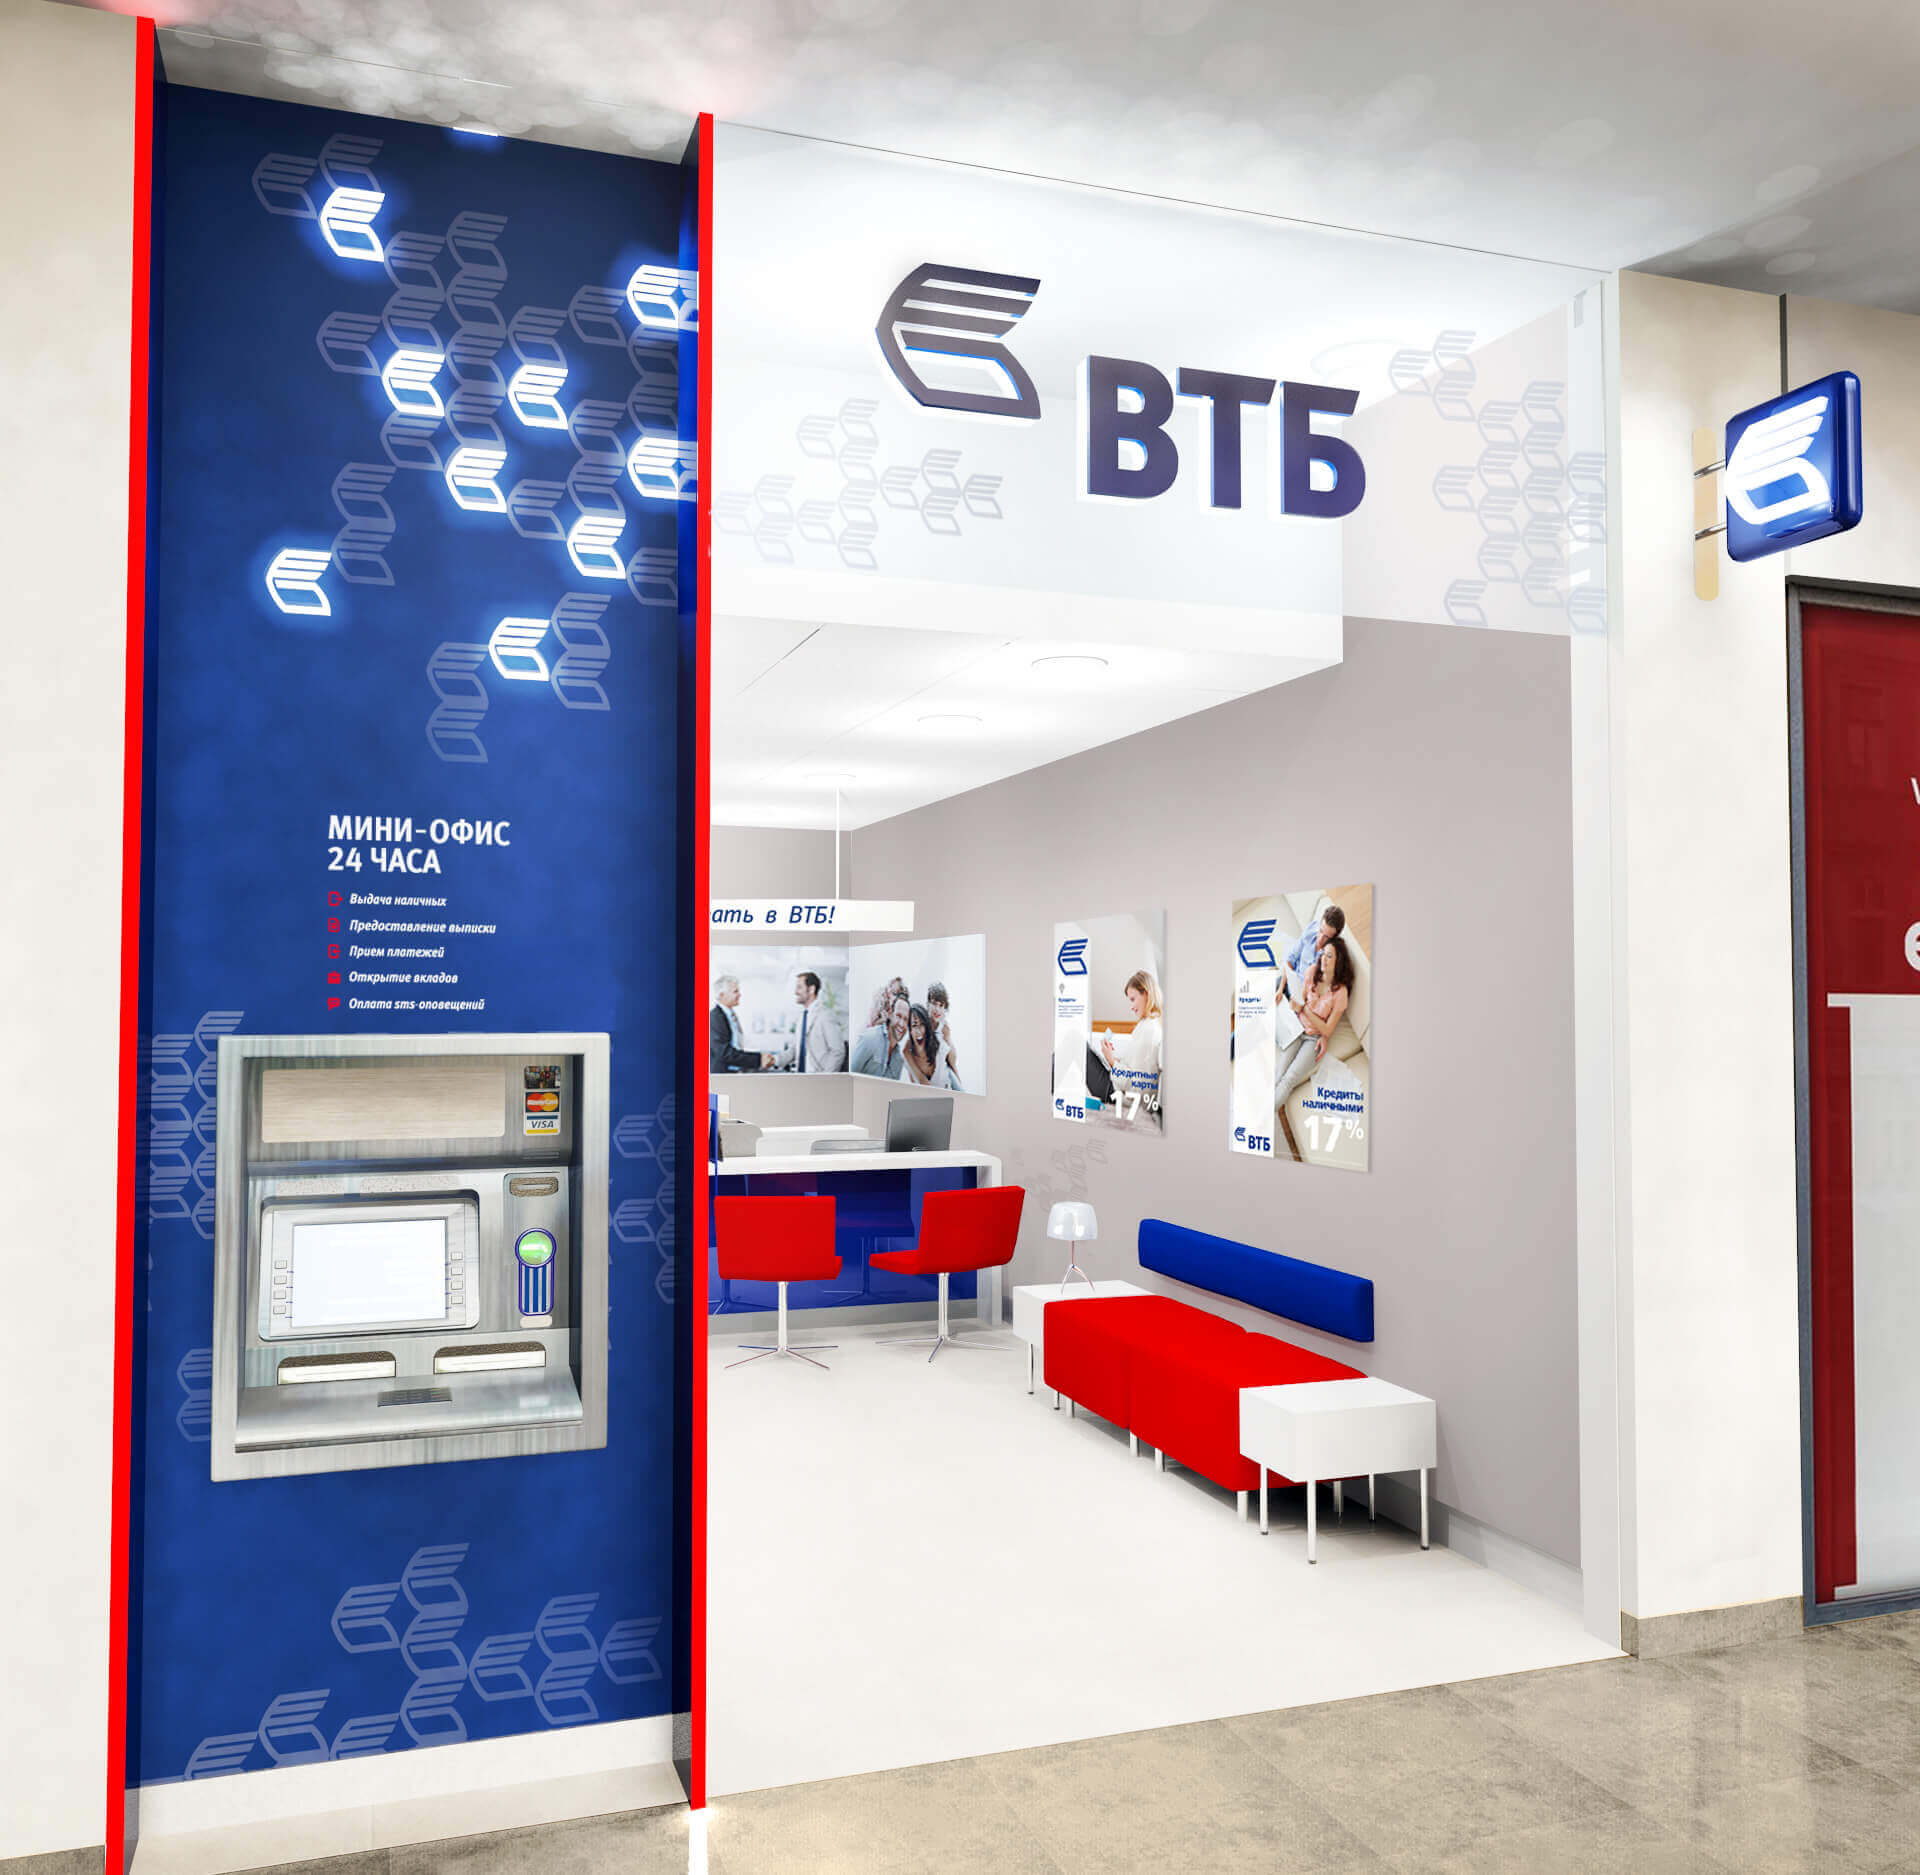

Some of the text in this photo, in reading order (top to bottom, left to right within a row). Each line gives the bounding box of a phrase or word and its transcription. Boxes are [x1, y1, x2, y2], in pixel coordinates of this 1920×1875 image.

[1086, 354, 1366, 519] ВТБ
[327, 814, 511, 846] МИНИ-ОФИС
[327, 846, 442, 874] 24 ЧАСА
[350, 893, 447, 907] Выдача наличных
[710, 905, 836, 924] ать в ВТБ!
[349, 919, 496, 935] Предоставление выписки
[349, 945, 445, 959] Прием платежей
[348, 971, 459, 985] Открытие вкладов
[348, 998, 486, 1012] Оплата sms-оповещений
[1111, 1067, 1159, 1081] Кредитные
[1131, 1080, 1159, 1091] карты
[1317, 1087, 1364, 1101] Кредиты
[1065, 1105, 1084, 1119] ВТБ
[1110, 1089, 1159, 1121] 17%
[1302, 1099, 1364, 1114] наличными
[531, 1120, 554, 1128] VISA
[1303, 1114, 1364, 1153] 17%
[1248, 1134, 1271, 1152] ВТБ
